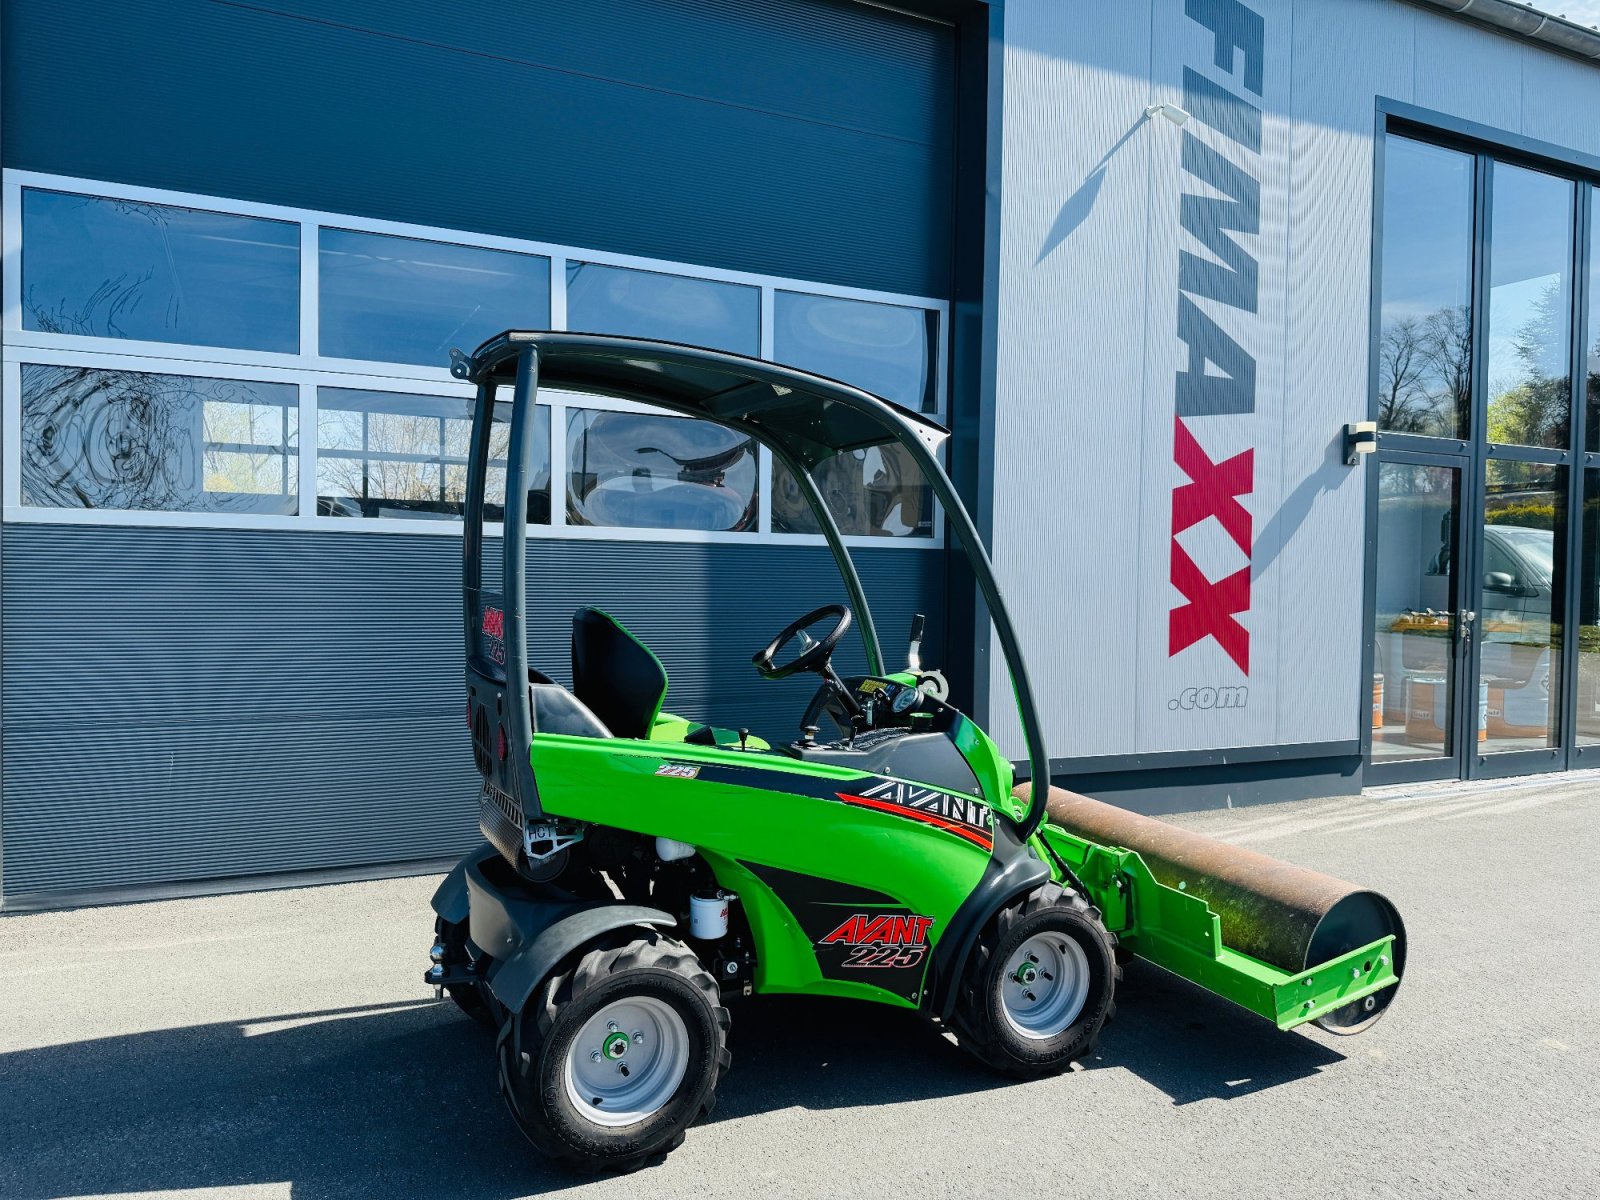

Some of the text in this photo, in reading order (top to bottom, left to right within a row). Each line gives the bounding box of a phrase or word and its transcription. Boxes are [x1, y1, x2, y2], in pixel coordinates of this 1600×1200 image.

[1167, 686, 1249, 711] .com
[818, 914, 934, 946] AVANT
[841, 946, 927, 968] 225
